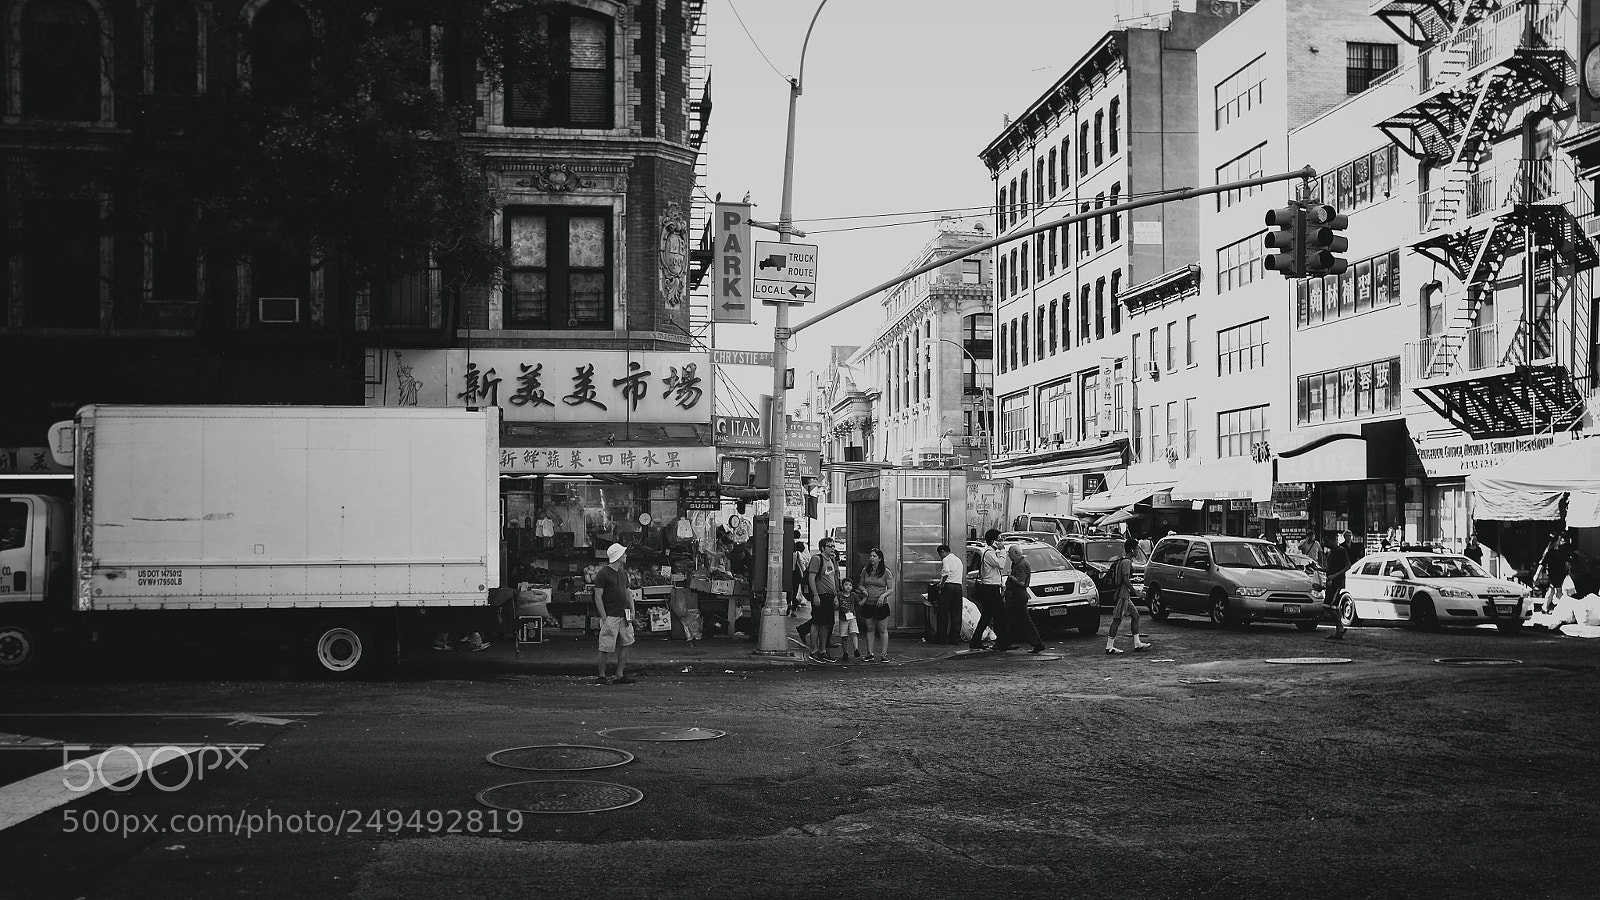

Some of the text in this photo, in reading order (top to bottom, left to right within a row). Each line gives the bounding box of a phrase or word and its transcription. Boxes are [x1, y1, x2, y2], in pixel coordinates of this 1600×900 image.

[722, 211, 742, 298] PARK
[788, 253, 814, 263] TRUCK
[788, 267, 814, 277] ROUTE
[755, 285, 786, 295] LOCAL
[713, 350, 759, 365] CHRYSTIE
[137, 570, 183, 578] US DOT 1475012
[1044, 585, 1064, 593] GMC
[1383, 585, 1406, 598] NYPD
